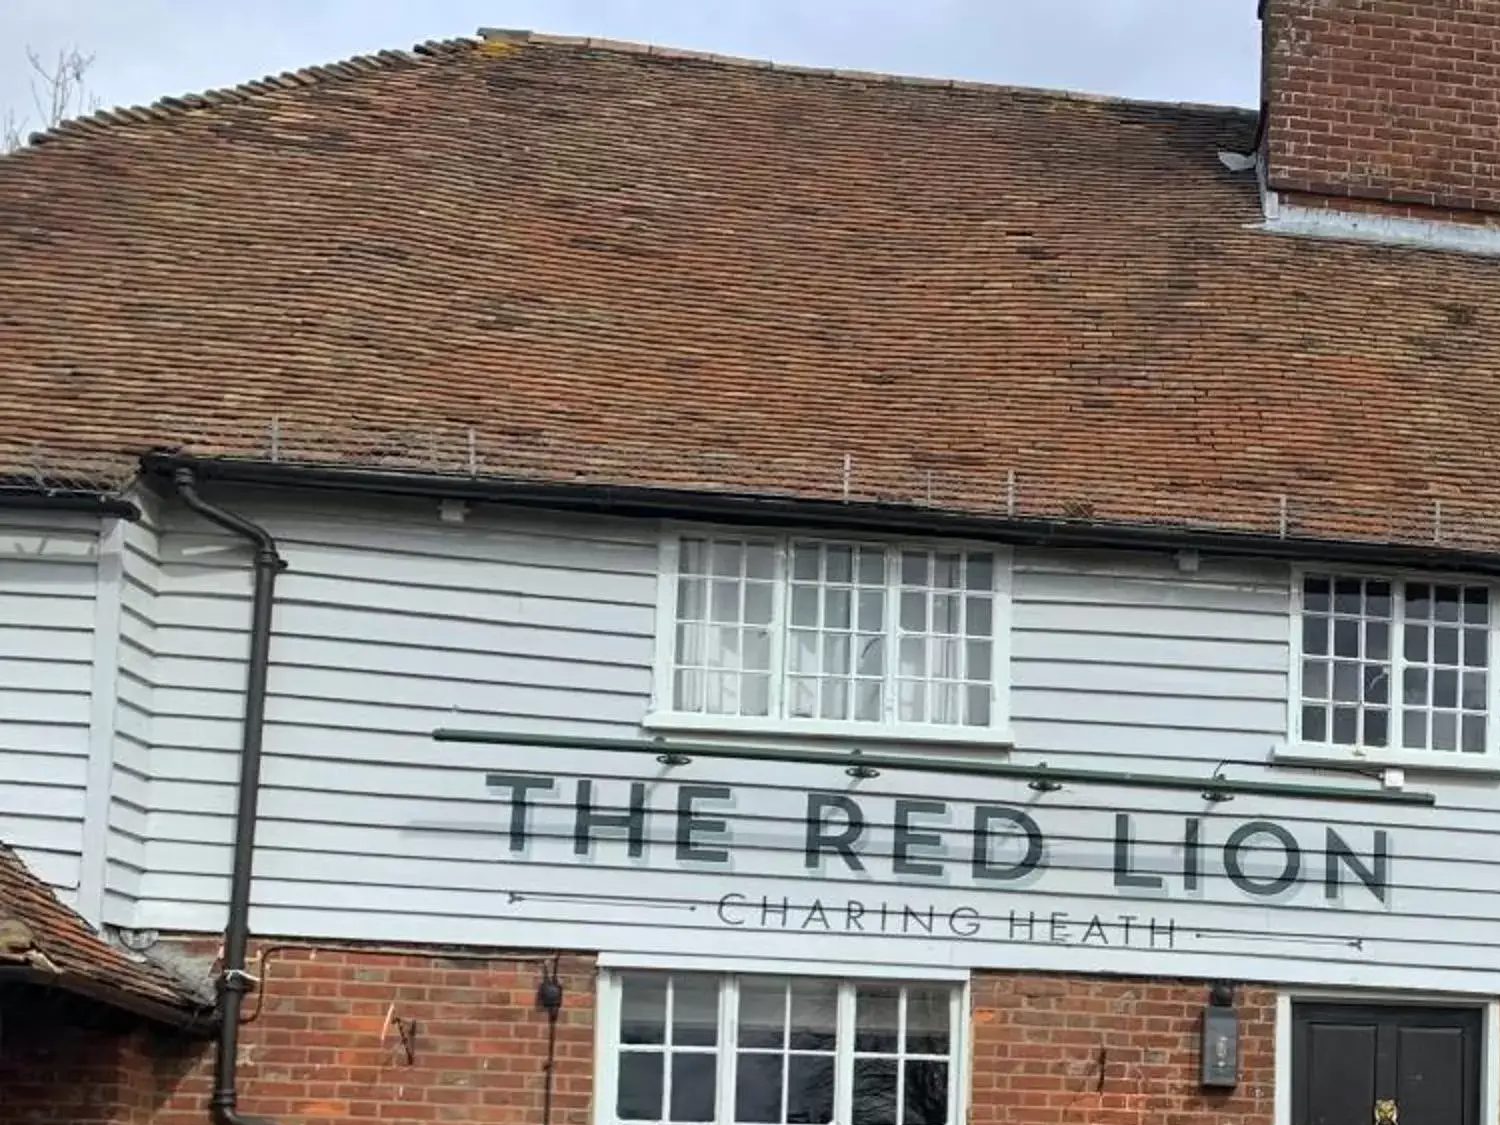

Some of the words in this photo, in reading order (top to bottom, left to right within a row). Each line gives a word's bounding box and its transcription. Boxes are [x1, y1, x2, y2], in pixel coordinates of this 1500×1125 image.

[486, 774, 733, 864] THE
[804, 792, 1045, 884] RED
[1112, 813, 1389, 906] LION
[717, 892, 982, 938] CHARING
[1008, 909, 1177, 949] HEATH
